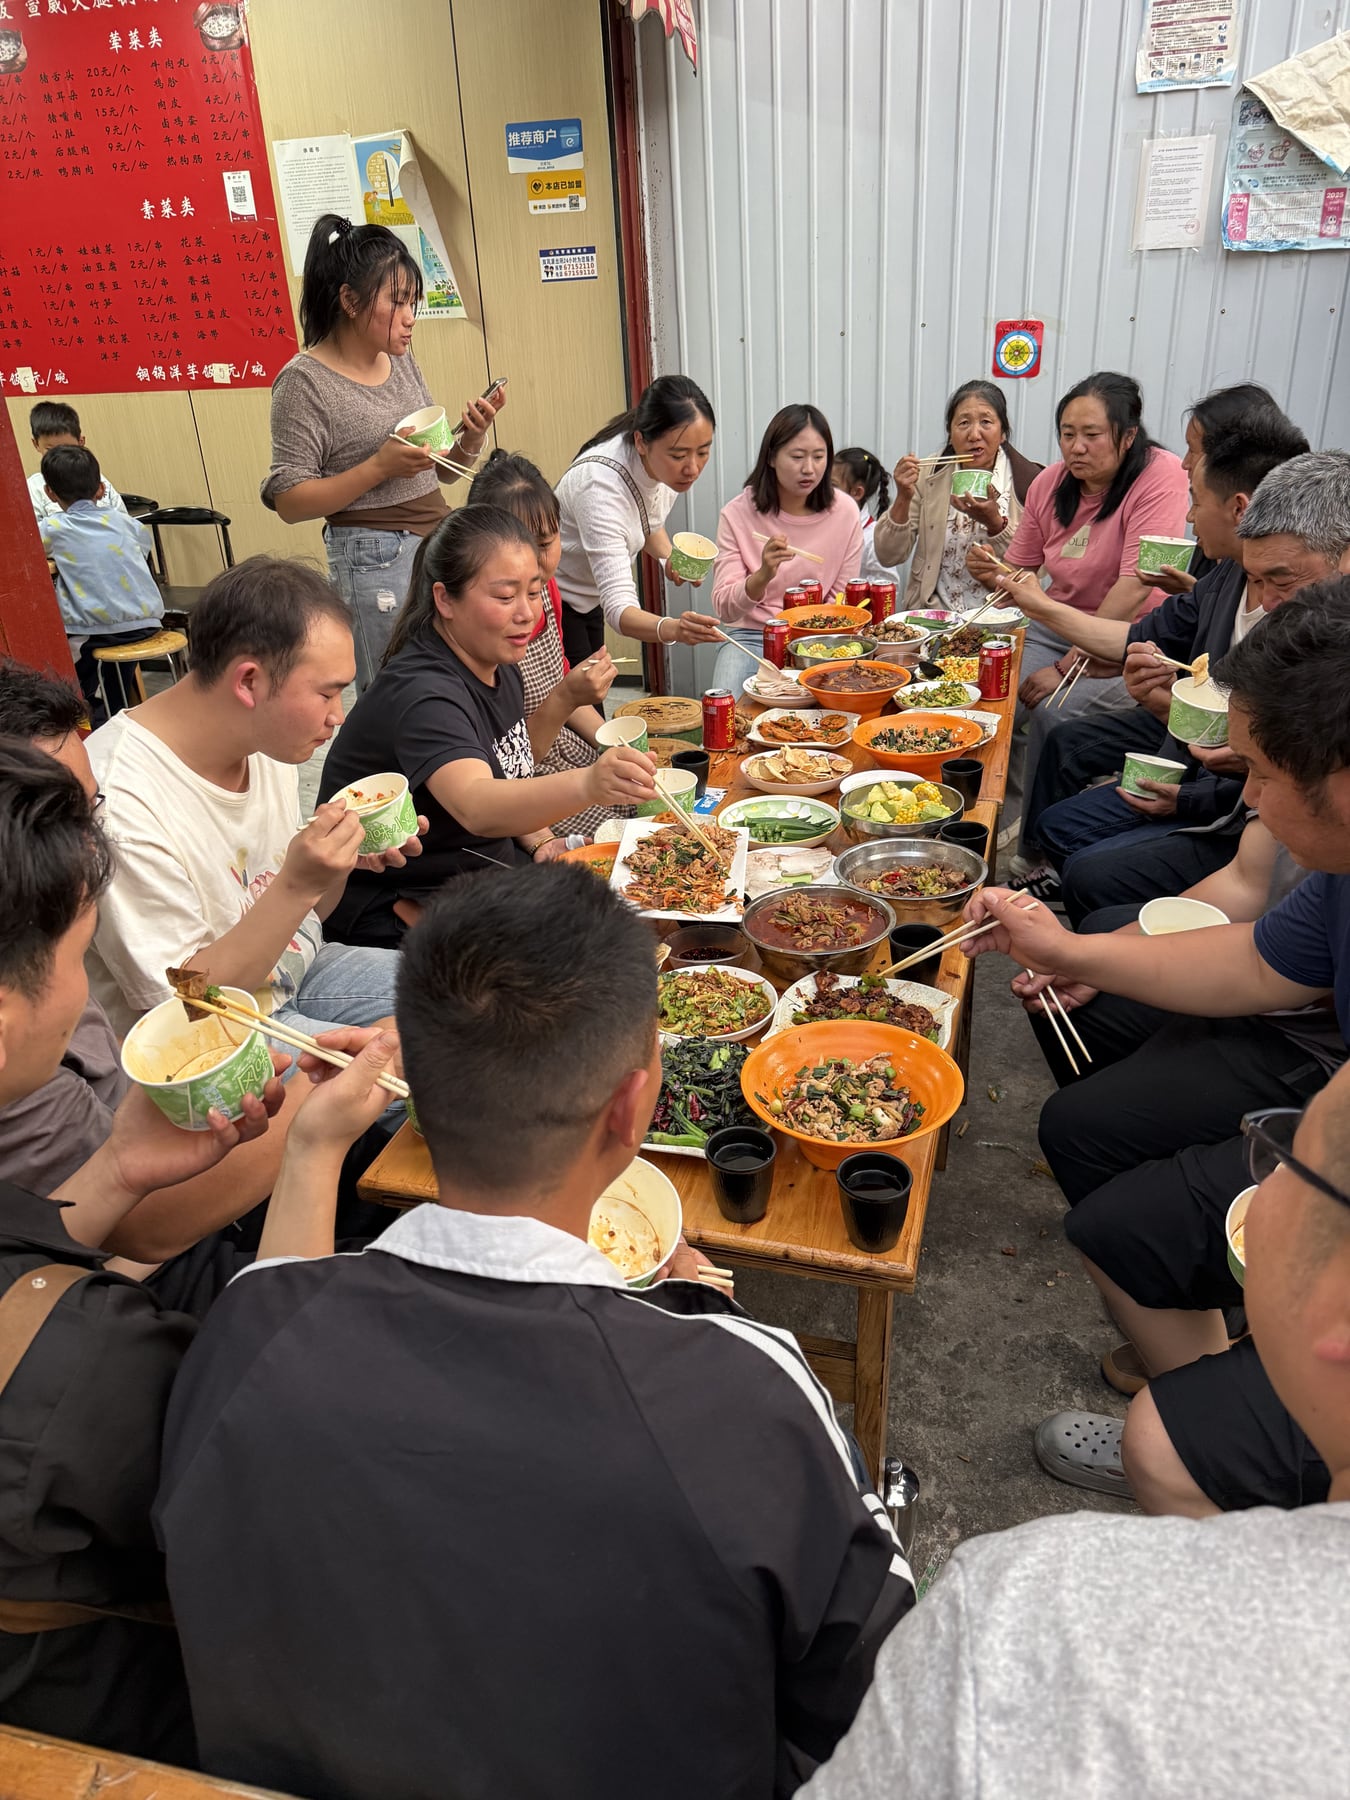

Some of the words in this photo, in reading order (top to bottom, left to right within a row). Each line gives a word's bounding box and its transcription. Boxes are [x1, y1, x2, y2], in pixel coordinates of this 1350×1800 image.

[109, 25, 163, 53] 荤菜类
[87, 64, 131, 77] 20元/个
[204, 71, 241, 84] 3元/个
[91, 84, 134, 97] 20元/个
[205, 92, 242, 105] 4元/片
[96, 104, 138, 117] 15元/个
[210, 111, 248, 123] 2元/个
[105, 122, 142, 136] 9元/个
[213, 129, 250, 141] 2元/串
[508, 129, 557, 147] 推荐商户
[4, 147, 38, 160] 2元/串
[56, 144, 90, 156] 后腿肉
[108, 139, 145, 152] 9元/个
[216, 149, 254, 162] 2元/根
[8, 168, 43, 180] 2元/根
[112, 159, 149, 172] 9元/份
[545, 180, 582, 190] 本店已加盟
[140, 195, 195, 220] 素菜类
[180, 236, 206, 248] 花菜
[232, 231, 271, 245] 1元/串
[29, 245, 64, 258] 1元/串
[78, 243, 115, 255] 娃娃菜
[127, 240, 163, 253] 1元/串
[183, 253, 222, 266] 金针菇
[236, 249, 274, 263] 1元/串
[34, 263, 69, 275] 1元/串
[130, 257, 167, 270] 2元/块
[241, 270, 277, 283] 1元/串
[40, 282, 73, 295] 1元/串
[134, 277, 169, 290] 1元/串
[243, 287, 280, 300] 1元/串
[43, 299, 77, 311] 1元/串
[138, 295, 177, 307] 2元/根
[247, 305, 283, 317] 1元/串
[48, 316, 80, 328] 1元/串
[94, 315, 118, 325] 小瓜
[142, 311, 180, 324] 1元/根
[51, 335, 84, 347] 1元/串
[146, 330, 180, 343] 1元/串
[250, 325, 287, 338] 1元/串
[151, 348, 183, 360] 1元/串
[1000, 658, 1010, 694] 王老吉
[726, 706, 734, 743] 王老吉
